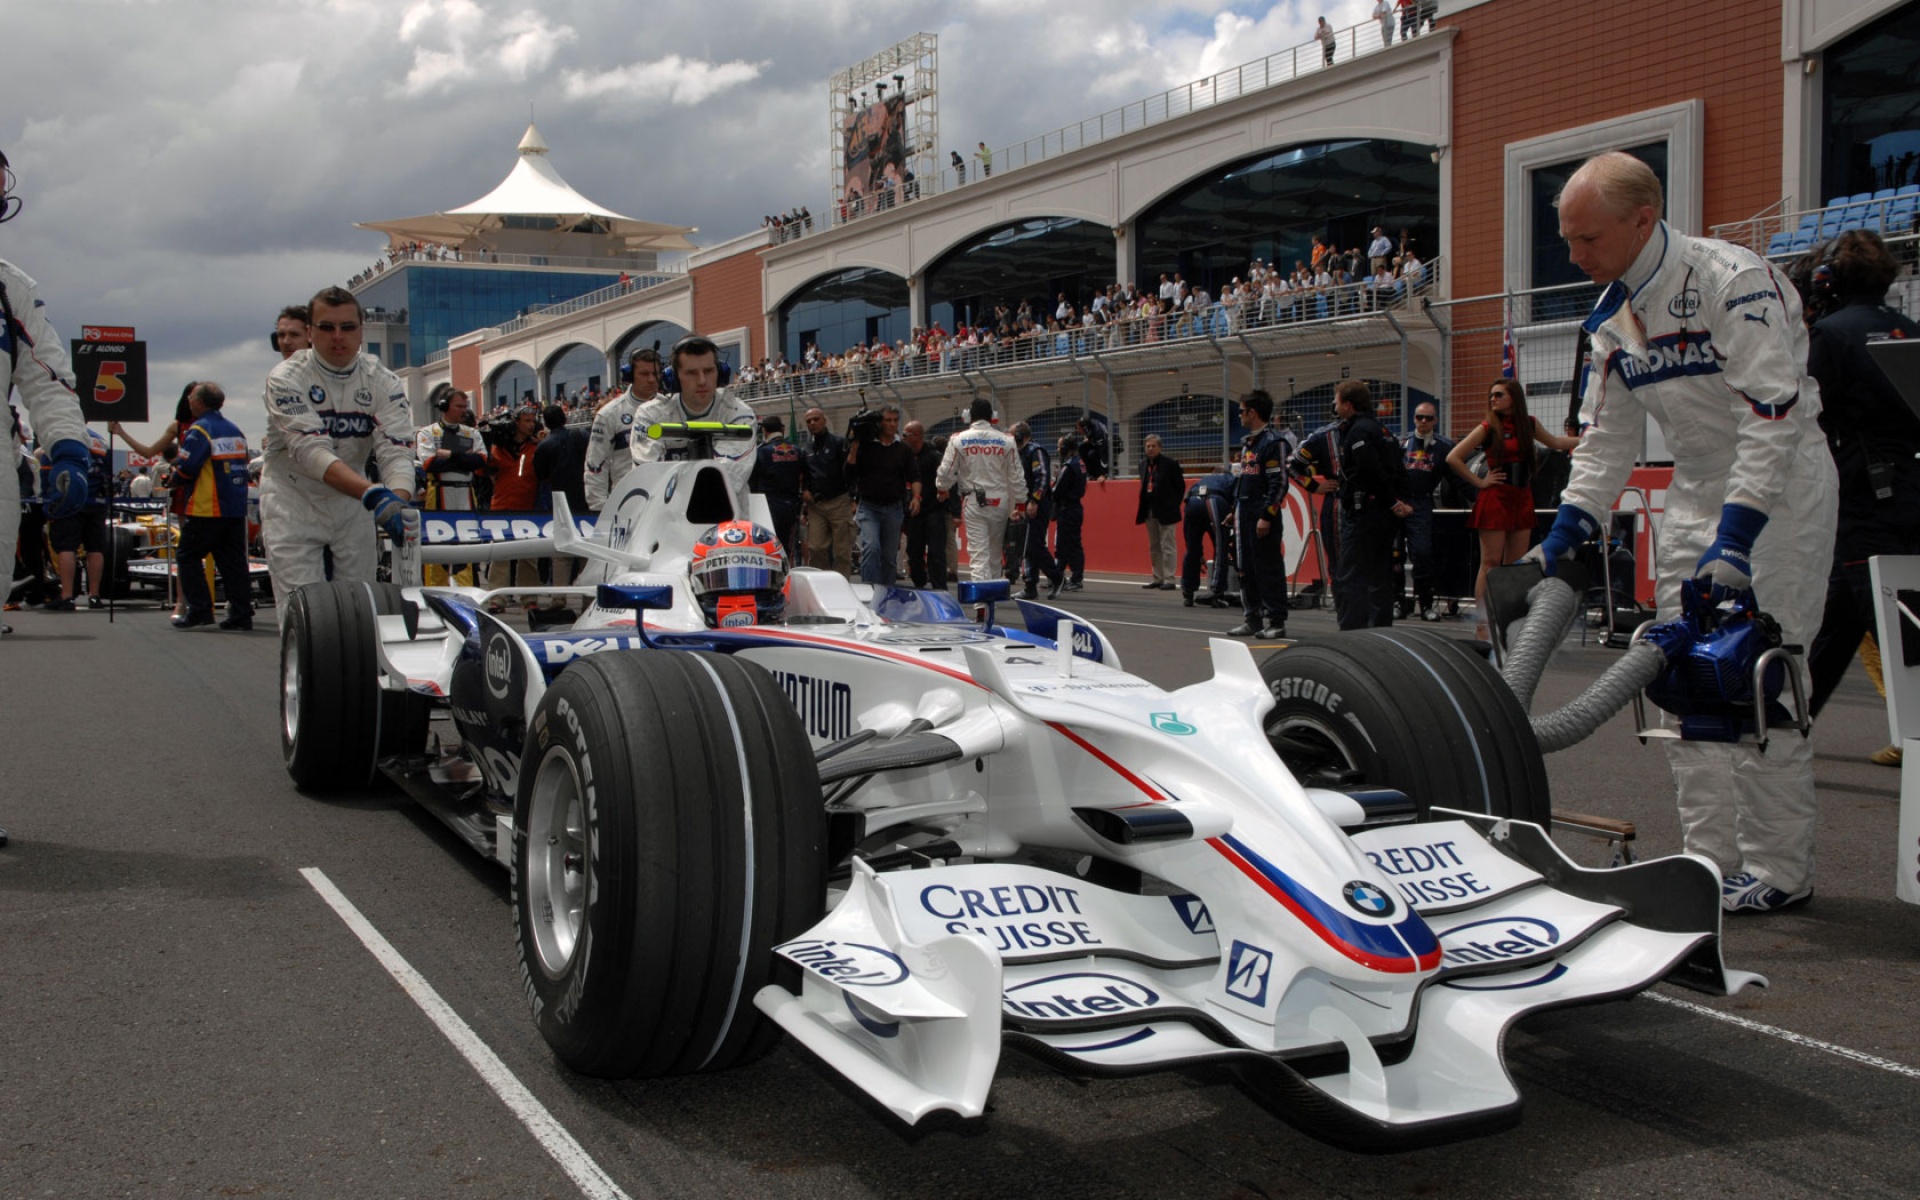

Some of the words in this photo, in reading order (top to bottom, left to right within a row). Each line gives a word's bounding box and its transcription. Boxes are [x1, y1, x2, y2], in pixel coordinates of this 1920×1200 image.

[96, 344, 125, 353] ALONSO
[94, 361, 127, 404] 5
[963, 446, 1005, 456] TOYOTA
[706, 555, 764, 570] PETRONAS
[725, 616, 749, 627] intel
[1072, 632, 1093, 654] ELL
[489, 648, 508, 681] intel
[1365, 841, 1464, 876] REDIT
[919, 884, 1082, 919] CREDIT
[1398, 872, 1491, 906] UISSE
[787, 940, 886, 982] intel
